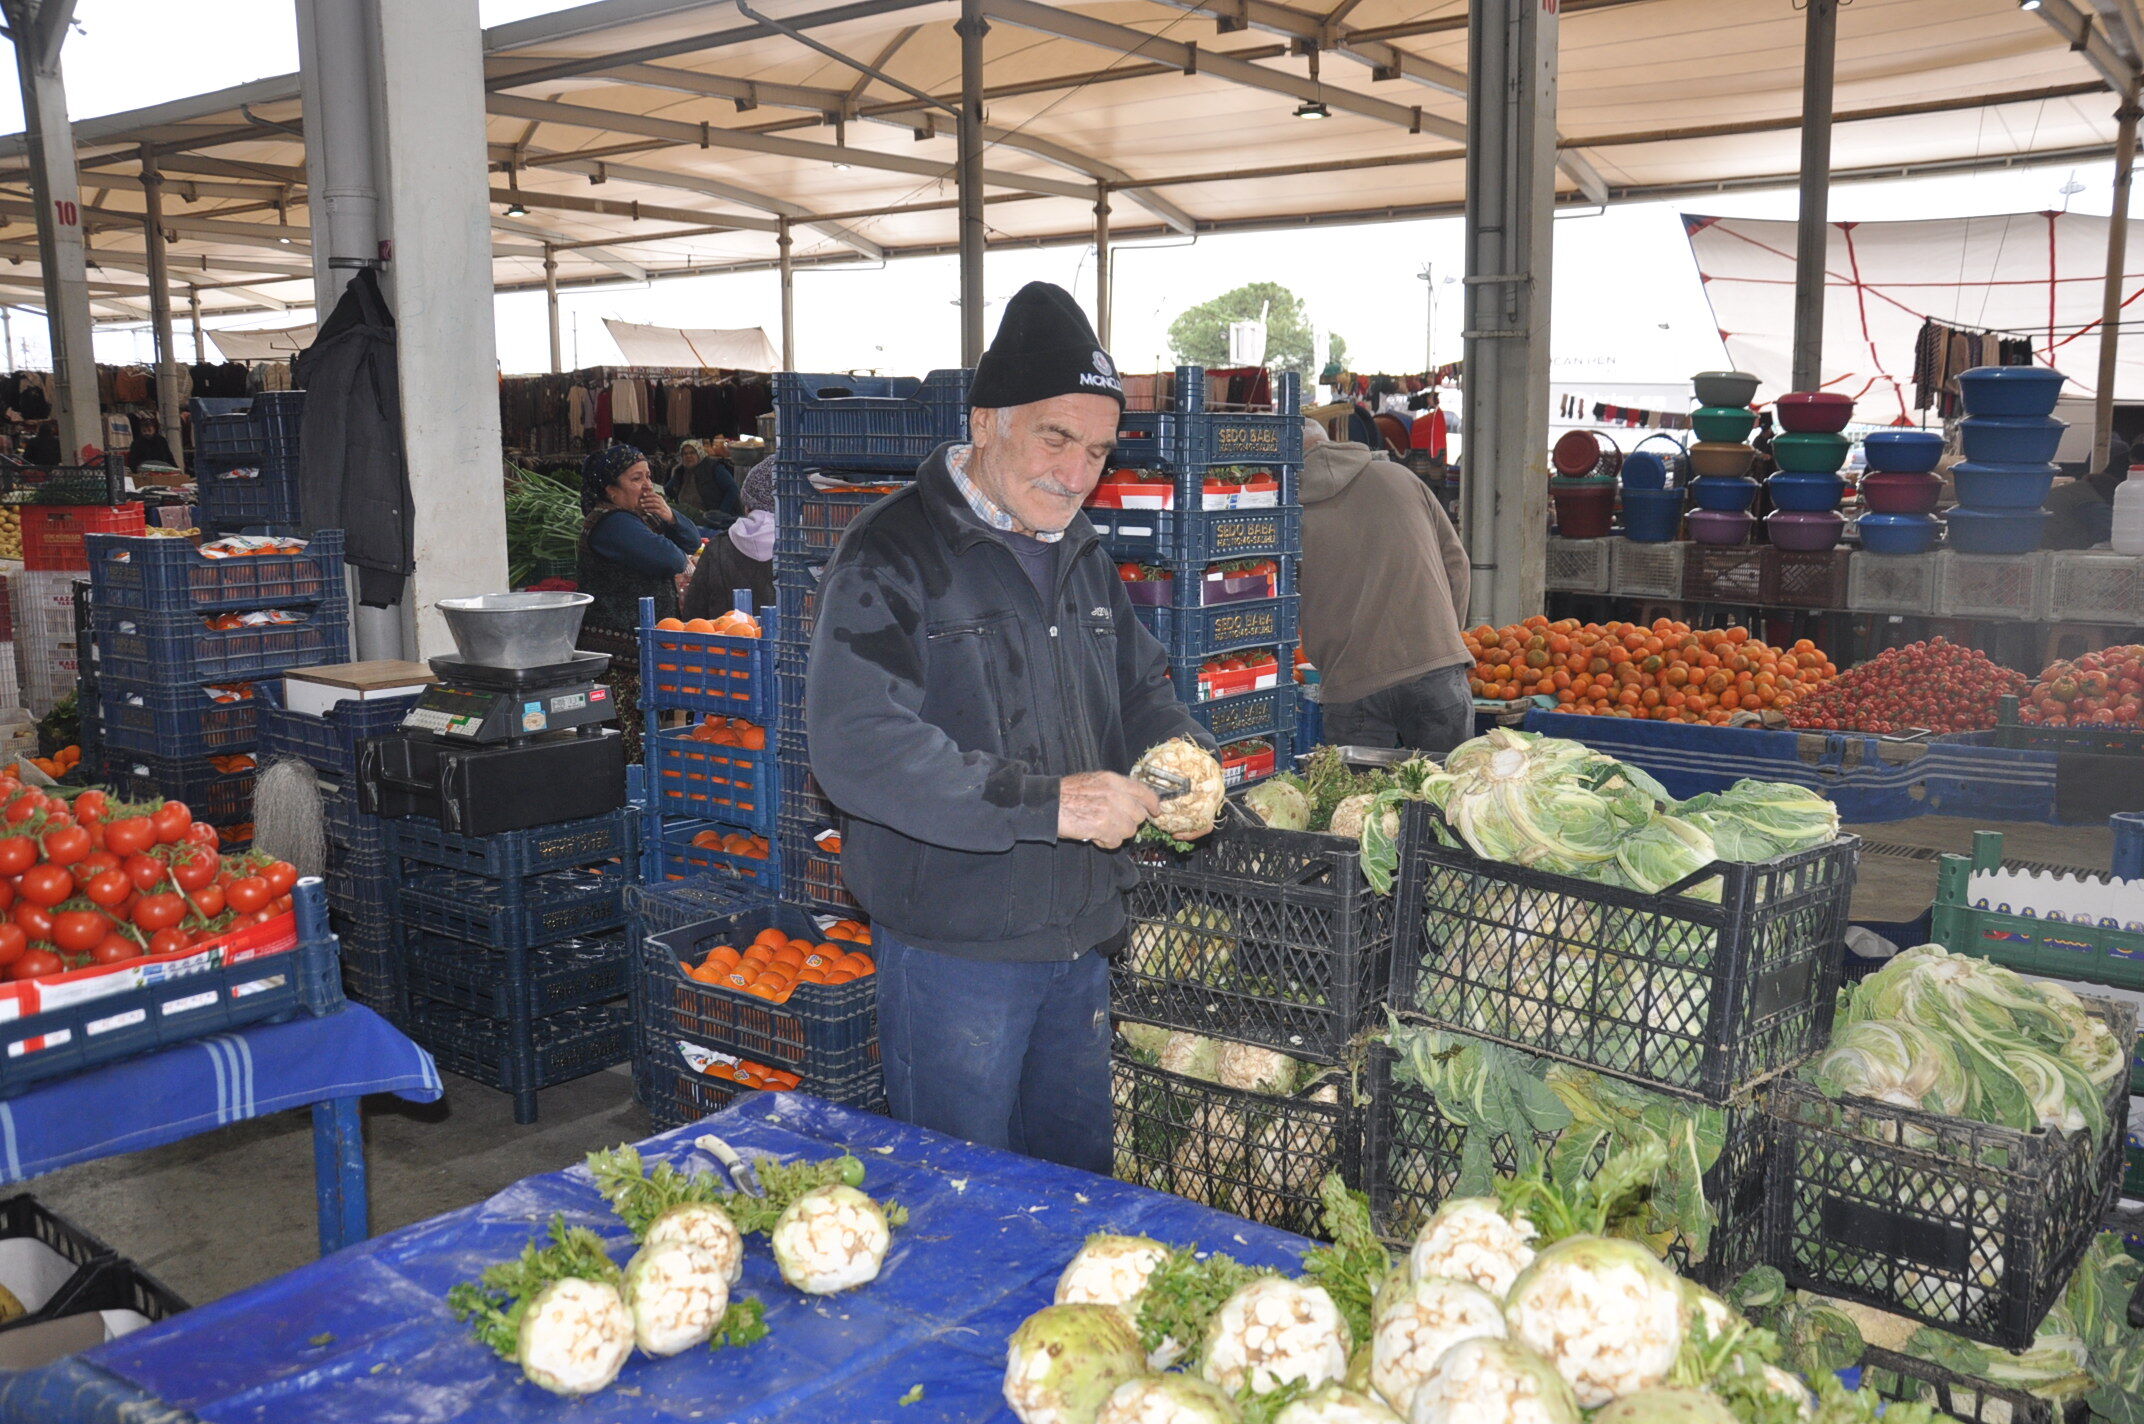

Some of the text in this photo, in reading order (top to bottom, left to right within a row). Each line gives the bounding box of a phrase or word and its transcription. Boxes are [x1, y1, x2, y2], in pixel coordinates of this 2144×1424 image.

[54, 200, 77, 226] 10
[1218, 428, 1278, 443] SEDO BABA
[1217, 523, 1276, 538] SEDO BABA
[1215, 613, 1273, 632] SEDO BABA
